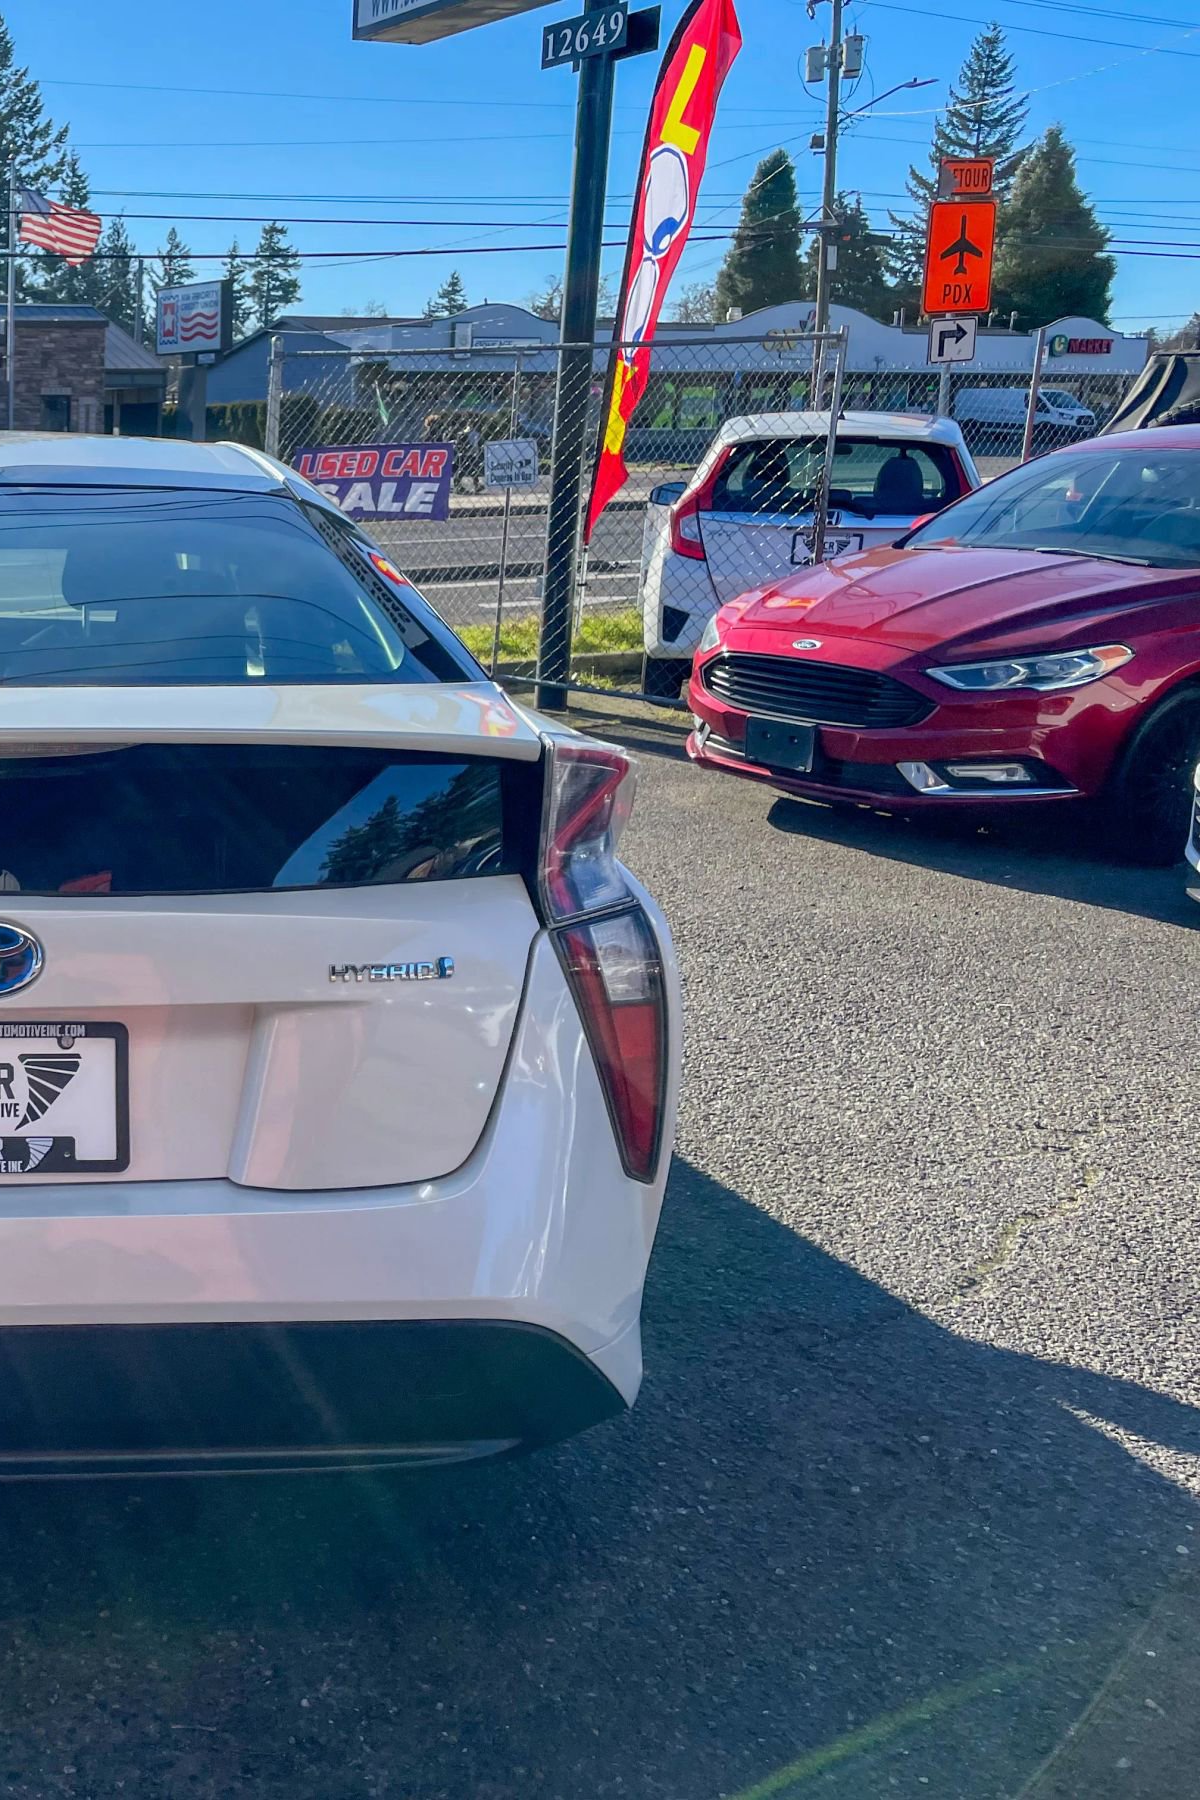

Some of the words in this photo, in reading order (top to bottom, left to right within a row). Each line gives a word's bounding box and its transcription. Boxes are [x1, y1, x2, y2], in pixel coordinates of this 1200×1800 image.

[546, 11, 624, 61] 12649
[942, 284, 973, 304] PDX
[1067, 338, 1113, 354] MARKET
[299, 451, 380, 480] USED
[381, 449, 449, 478] CAR
[316, 482, 440, 514] SALE
[329, 961, 434, 983] HYBRID
[8, 1161, 23, 1173] INC
